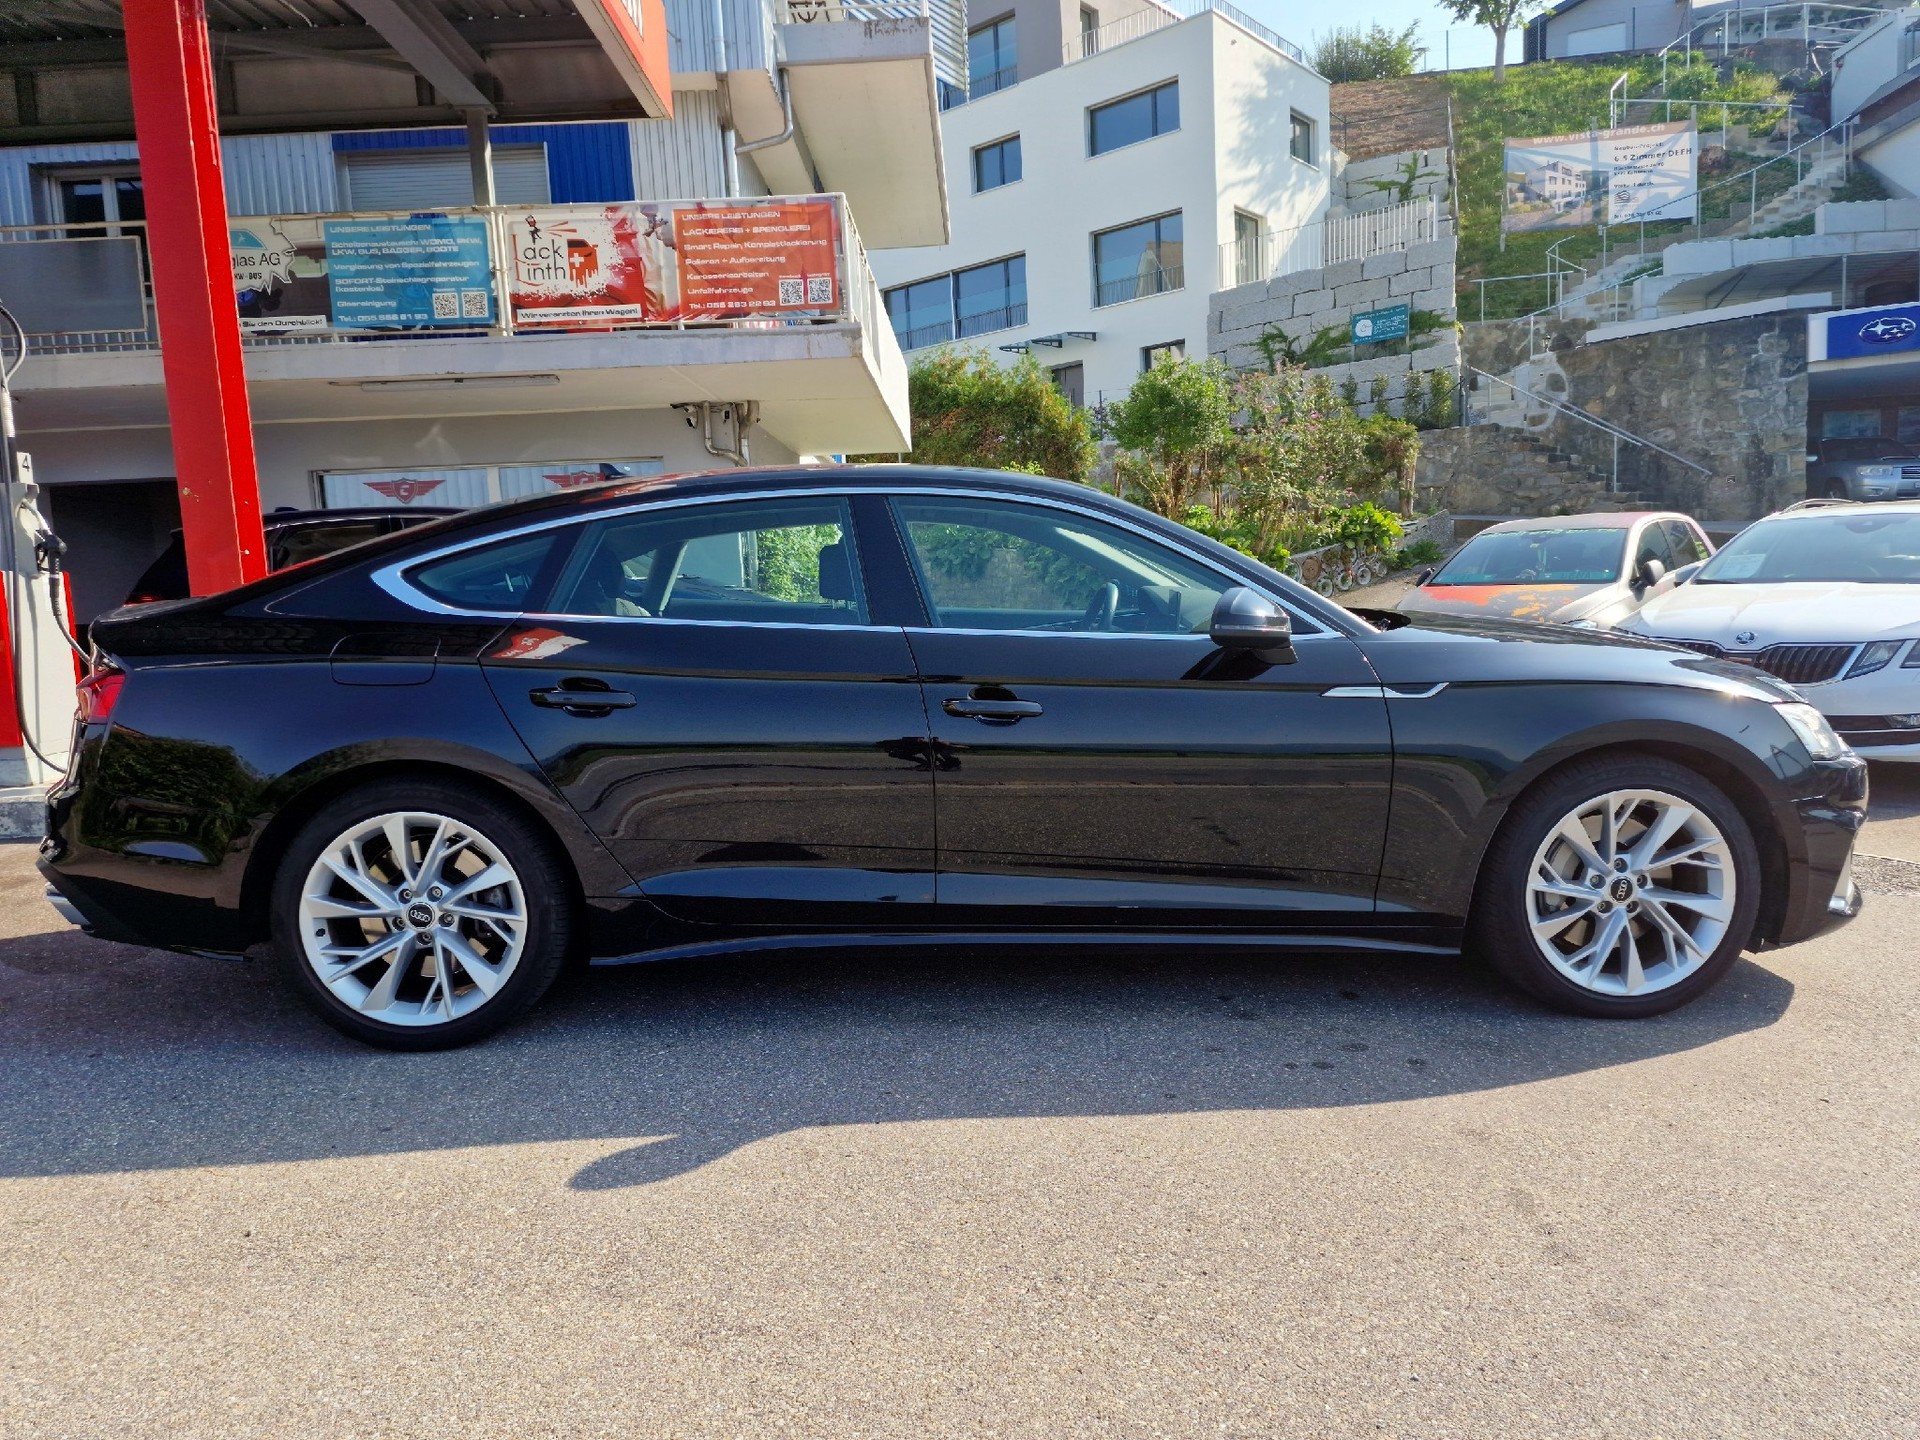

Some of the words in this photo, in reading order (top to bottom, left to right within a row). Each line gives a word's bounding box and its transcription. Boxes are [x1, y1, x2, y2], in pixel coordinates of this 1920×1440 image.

[1533, 123, 1665, 145] www.vista-grande.ch
[1630, 151, 1666, 161] Zimmer
[682, 213, 720, 221] UNSERE
[721, 211, 780, 219] LEISTUNGEN
[370, 224, 431, 232] LEISTUNGEN
[683, 228, 743, 236] LACKIEREREI
[752, 225, 811, 234] SPENGLEREI
[744, 239, 827, 250] Komplettlackierung
[332, 248, 357, 256] LKW,
[382, 246, 425, 255] BAGGER,
[426, 245, 459, 253] BOOTE
[259, 252, 281, 266] AG
[729, 256, 786, 264] Aufbereitung
[334, 263, 383, 271] Verglasung
[248, 272, 262, 280] BUS
[335, 275, 469, 285] SOFORT-Steinschlagreparatur
[686, 272, 770, 280] Karosseriearbeiten
[335, 285, 384, 293] (kostenlos)
[687, 287, 754, 295] Unfallfahrzeuge
[582, 309, 605, 317] Ihren
[605, 308, 638, 316] Wagen!
[357, 314, 377, 322] 055
[242, 320, 255, 328] Sie
[275, 319, 323, 327] Durchblick!
[22, 454, 30, 472] 4
